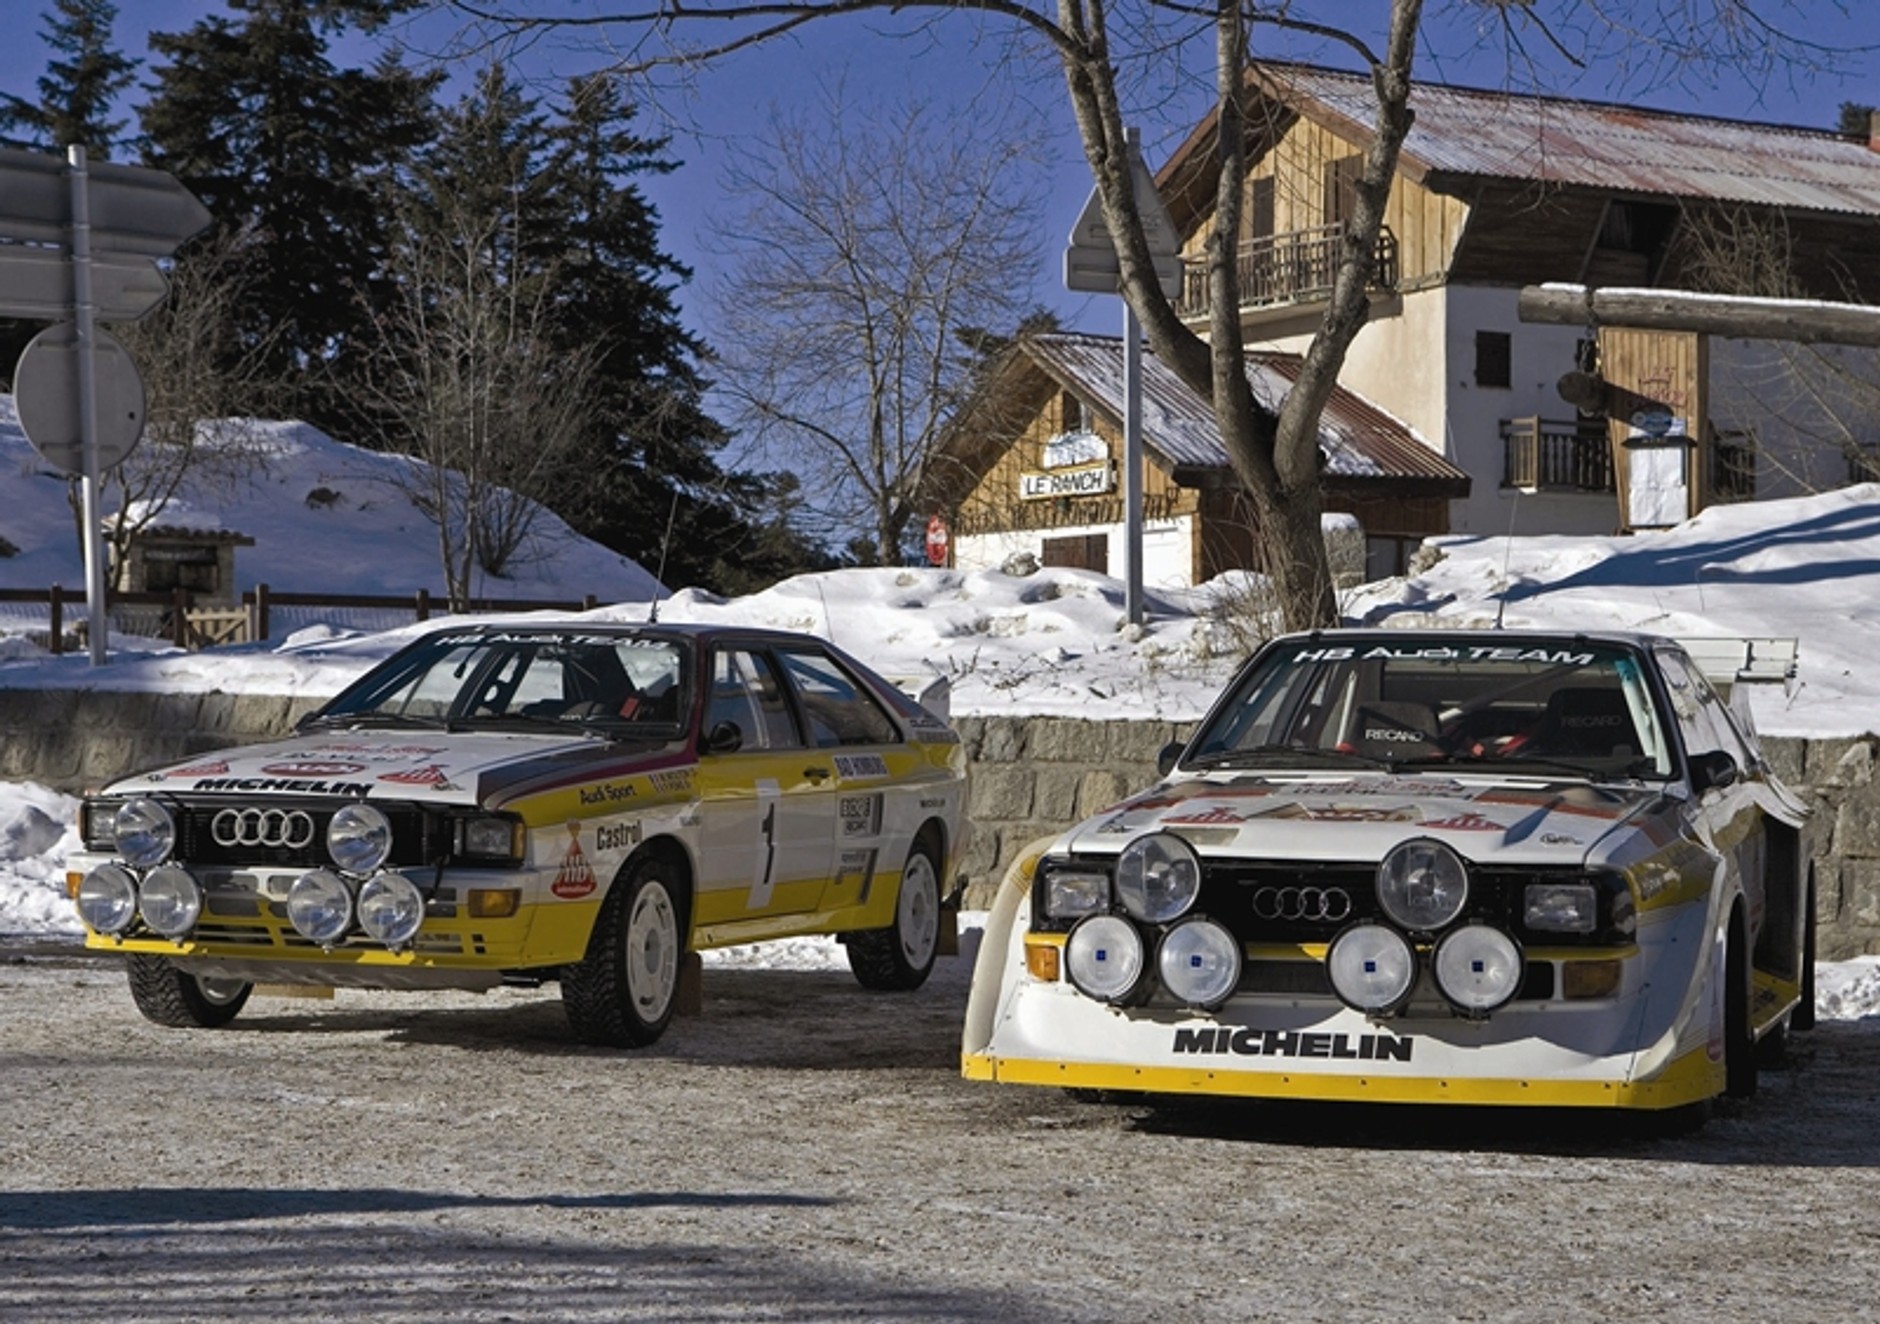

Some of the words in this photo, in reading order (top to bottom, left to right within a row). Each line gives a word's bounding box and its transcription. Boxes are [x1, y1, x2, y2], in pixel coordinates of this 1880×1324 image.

[1026, 478, 1045, 495] LE
[1050, 471, 1103, 493] RANCH
[1293, 647, 1355, 663] HB
[1468, 646, 1595, 665] TEAM
[1558, 715, 1622, 729] RECARO
[1365, 728, 1424, 743] RECARO
[193, 778, 375, 798] MICHELIN
[580, 787, 606, 804] Audi
[607, 783, 638, 801] Sport
[596, 820, 643, 851] Castrol
[762, 802, 775, 885] 1
[1172, 1028, 1413, 1062] MICHELIN
